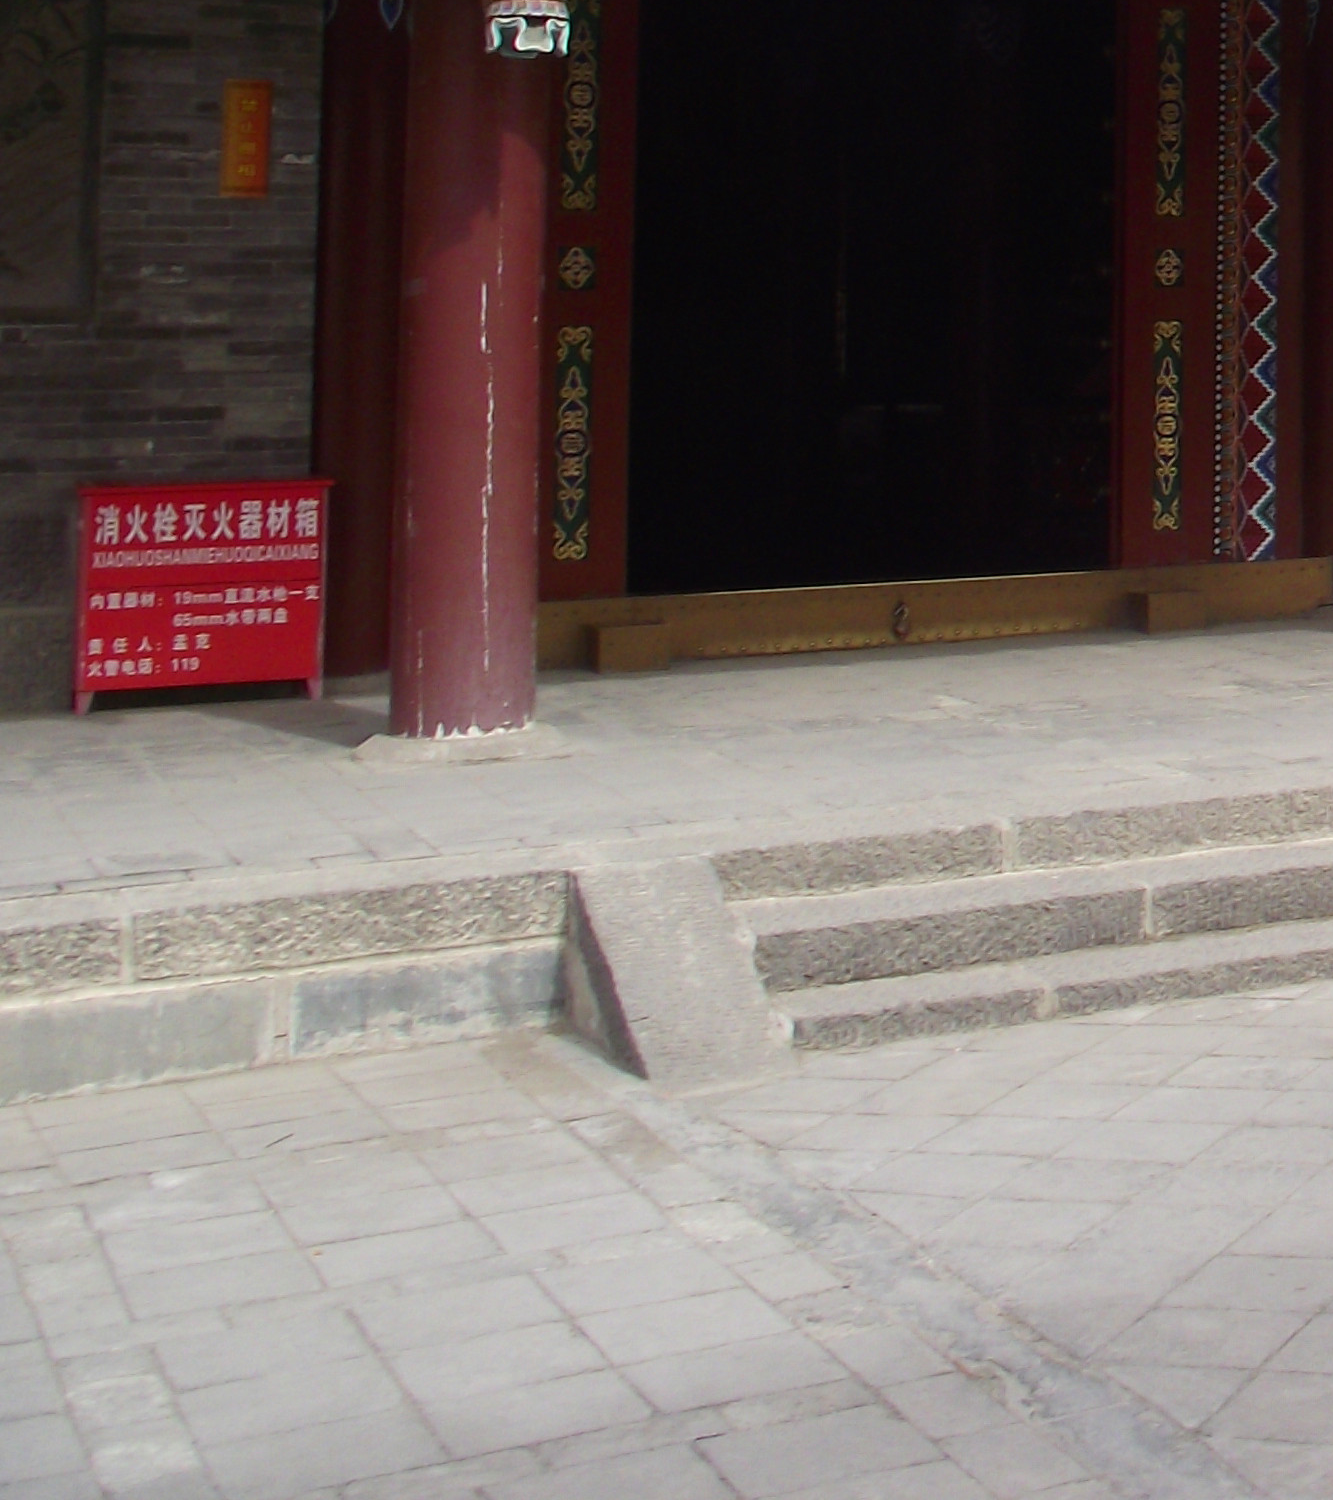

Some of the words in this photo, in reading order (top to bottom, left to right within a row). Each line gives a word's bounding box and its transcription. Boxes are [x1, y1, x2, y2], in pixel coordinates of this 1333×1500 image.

[95, 497, 319, 545] 消火栓灭火器材箱
